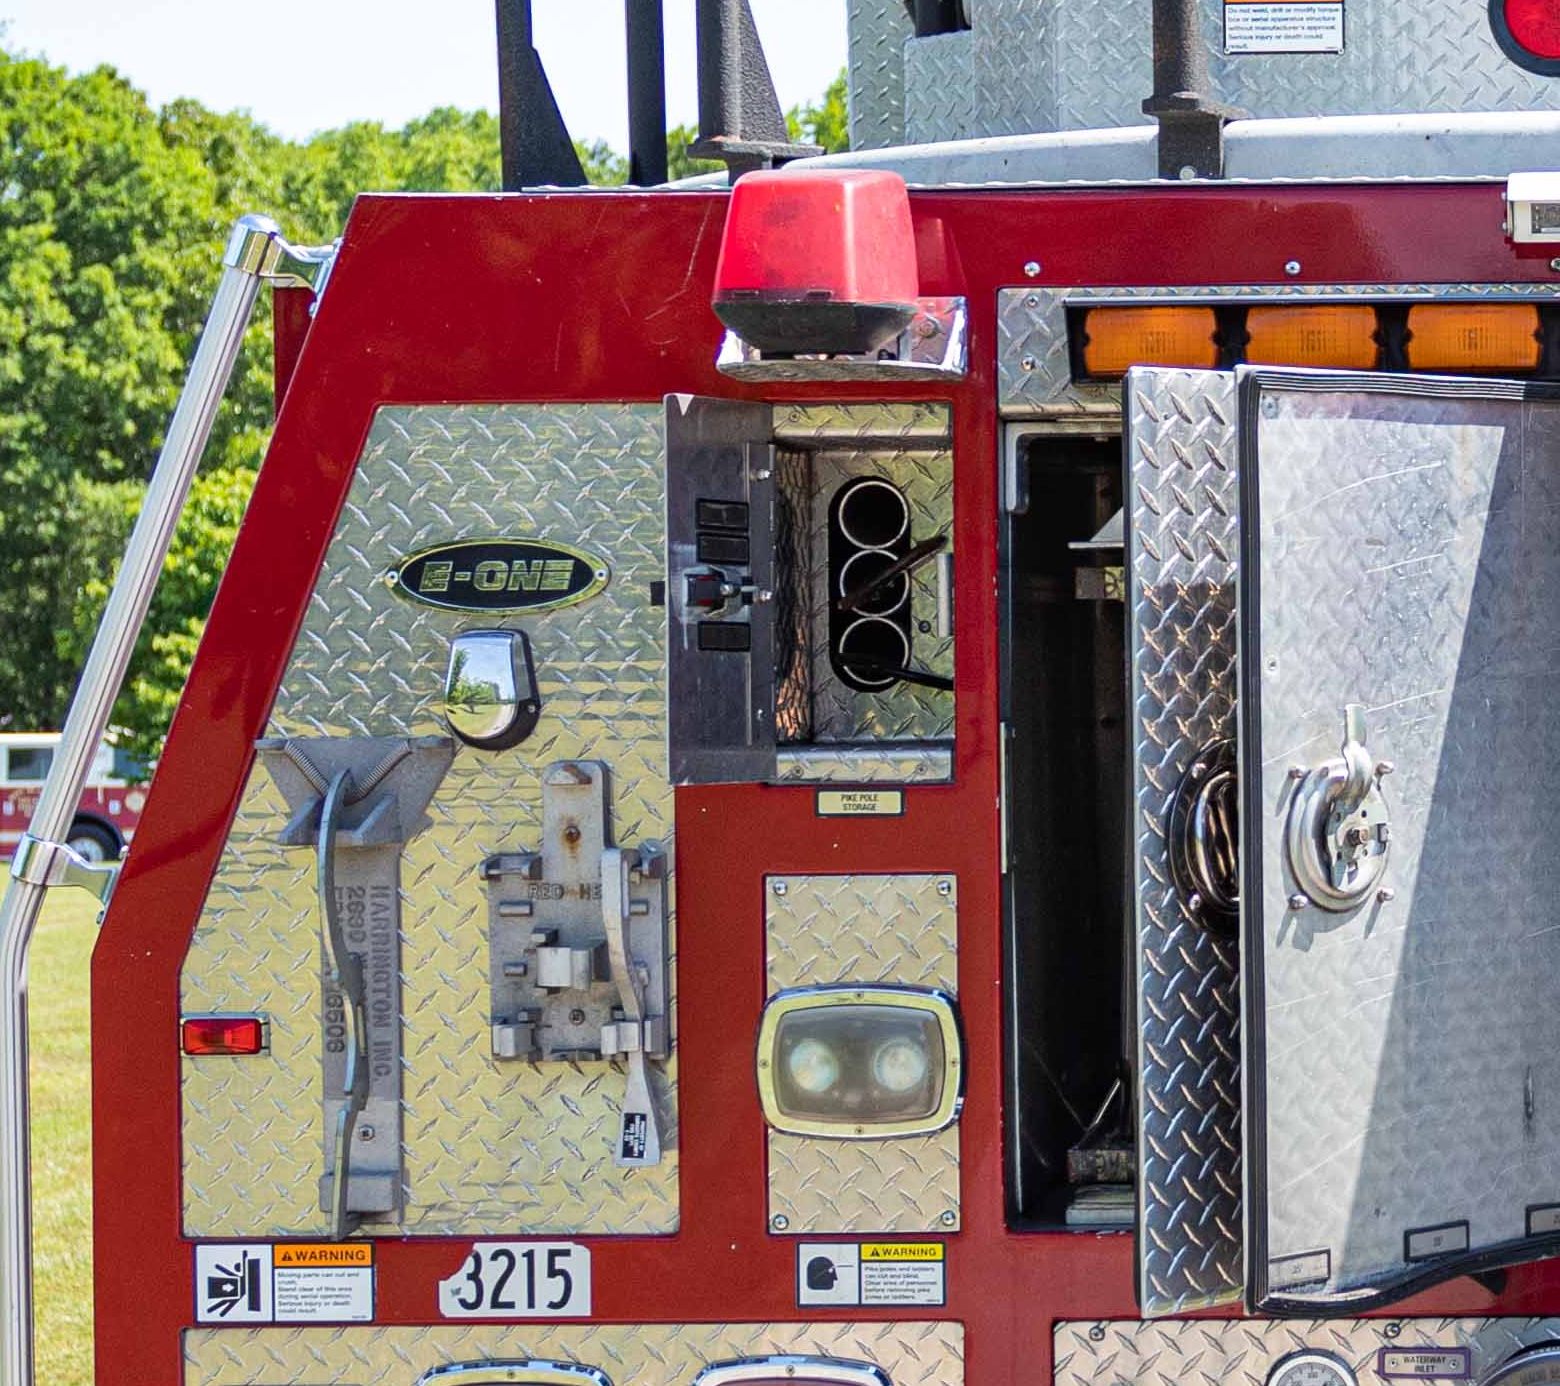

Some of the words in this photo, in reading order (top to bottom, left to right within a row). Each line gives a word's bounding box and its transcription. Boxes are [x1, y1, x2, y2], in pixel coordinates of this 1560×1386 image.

[419, 560, 574, 592] E-ONE
[841, 794, 857, 802] PIKE
[860, 794, 879, 802] POLE
[843, 803, 876, 811] STORAGE
[296, 1250, 366, 1261] WARNING
[882, 1248, 936, 1257] WARNING
[457, 1249, 573, 1310] 3215
